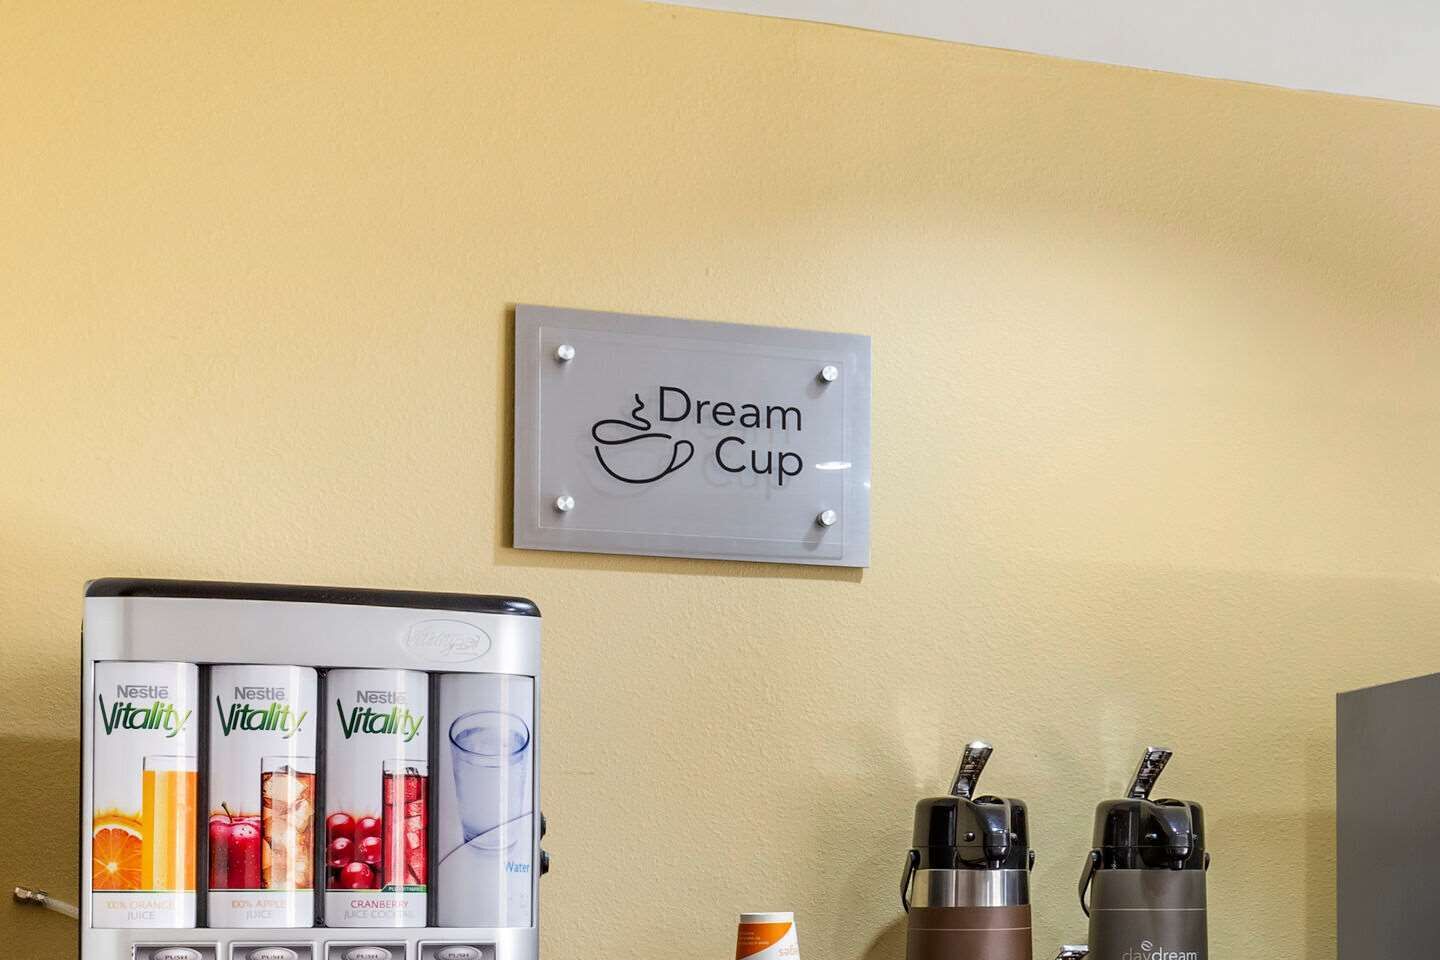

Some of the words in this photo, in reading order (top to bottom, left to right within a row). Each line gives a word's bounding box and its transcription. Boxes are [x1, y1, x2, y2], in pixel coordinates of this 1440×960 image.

[659, 386, 802, 431] Dream
[715, 436, 804, 486] Cup
[99, 693, 193, 738] Vitality
[216, 695, 308, 739] Vitality
[336, 698, 424, 743] Vitality
[126, 911, 157, 921] JUICE
[245, 911, 273, 920] JUICE
[350, 900, 410, 910] CRANBERRY
